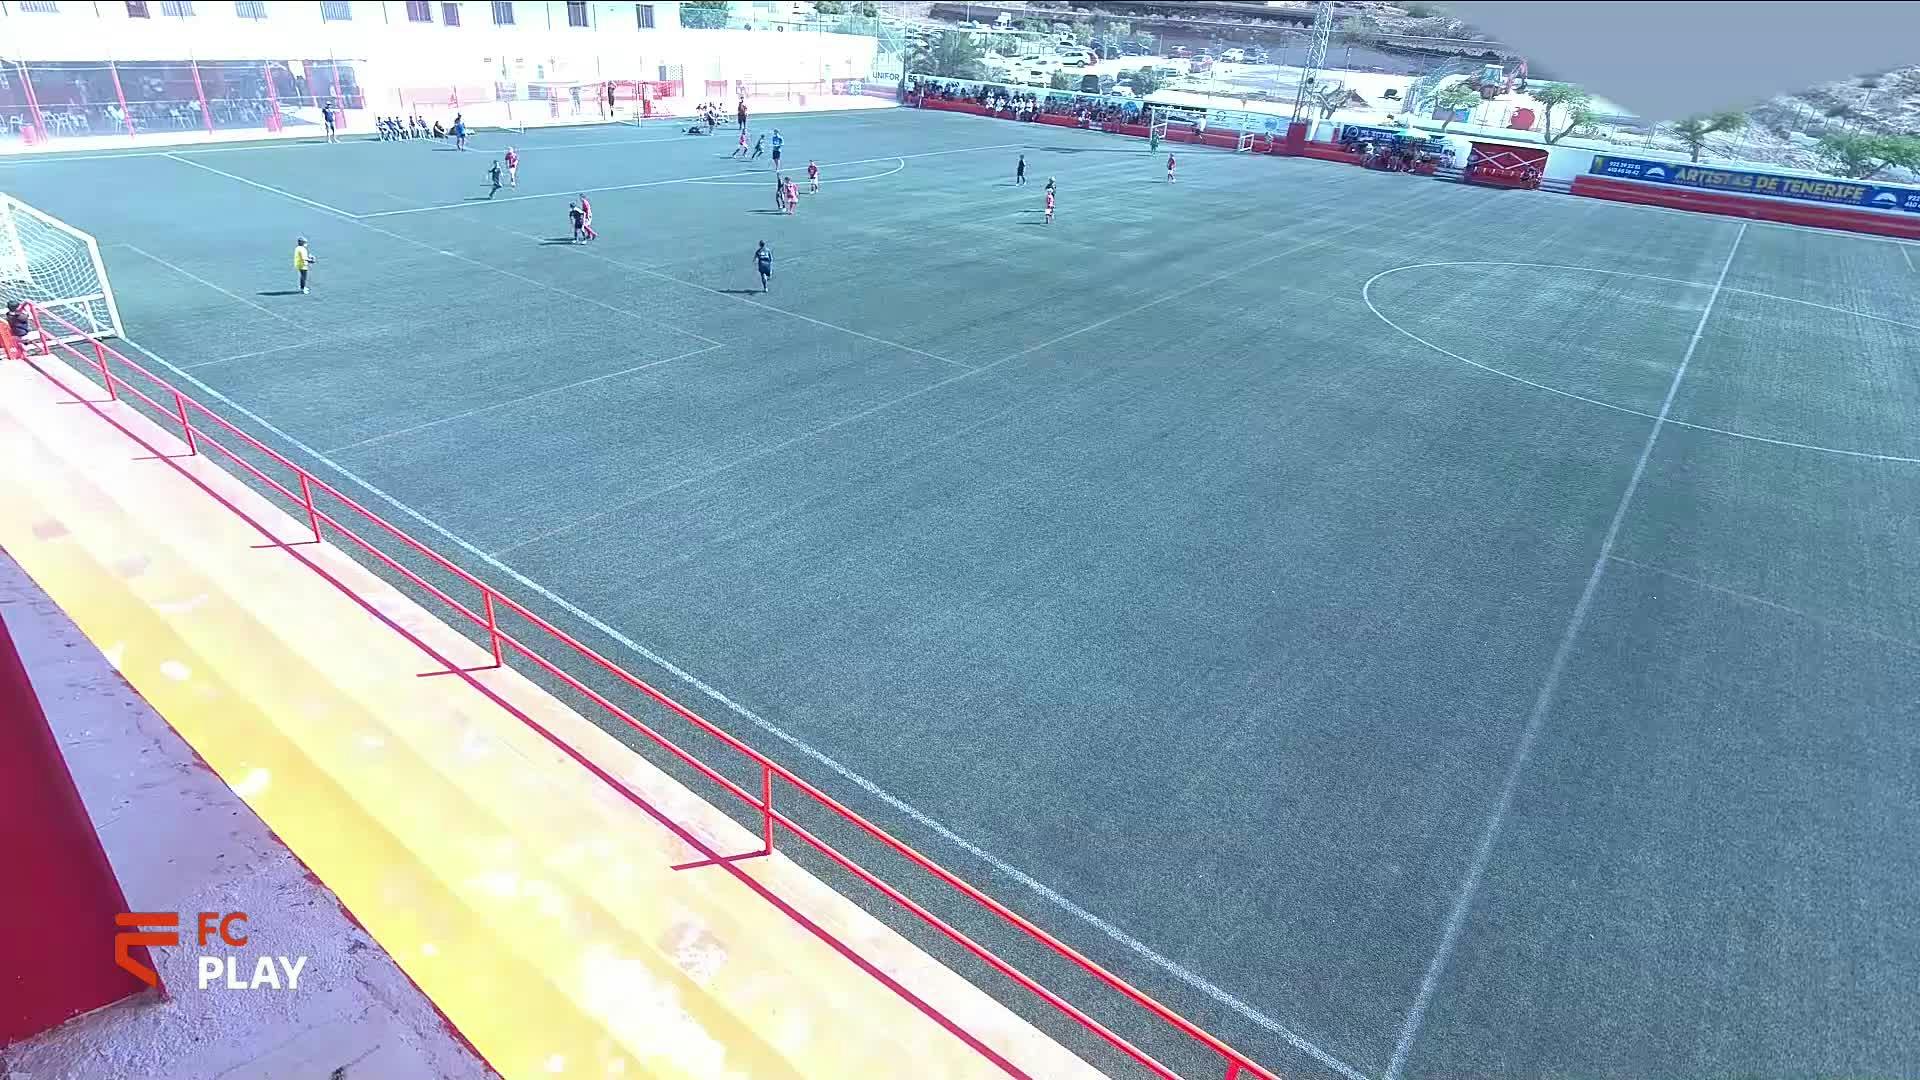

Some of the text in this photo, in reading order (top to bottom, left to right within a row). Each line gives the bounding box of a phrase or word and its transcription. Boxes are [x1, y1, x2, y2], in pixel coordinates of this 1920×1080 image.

[1674, 167, 1753, 187] ARTISTAS
[1756, 174, 1778, 190] DE
[1783, 179, 1865, 200] TENERIFE
